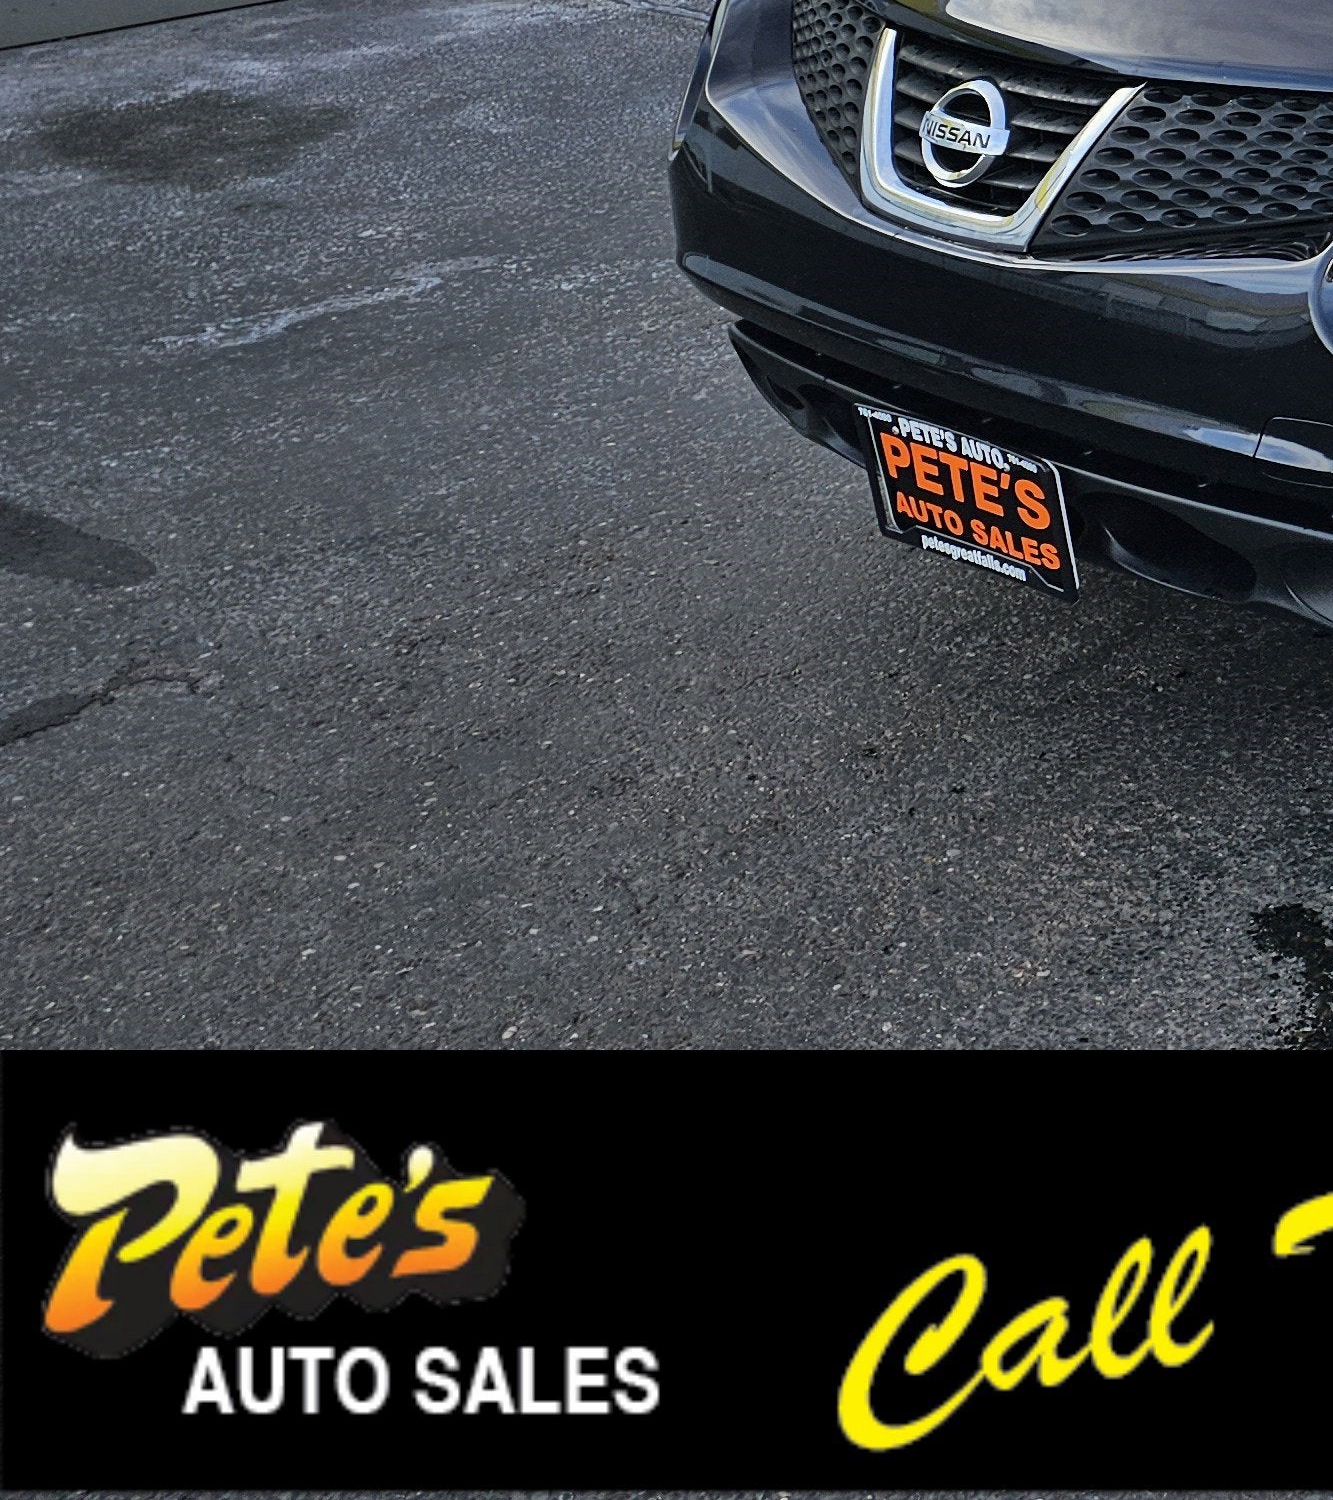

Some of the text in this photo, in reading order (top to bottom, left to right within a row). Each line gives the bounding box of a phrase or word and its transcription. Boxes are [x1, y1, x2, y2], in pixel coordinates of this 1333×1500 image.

[921, 118, 992, 149] NISSAN
[897, 416, 958, 453] PETE'S
[960, 436, 1005, 470] AUTO
[880, 431, 1051, 530] PETE'S
[896, 490, 1062, 570] AUTO SALES
